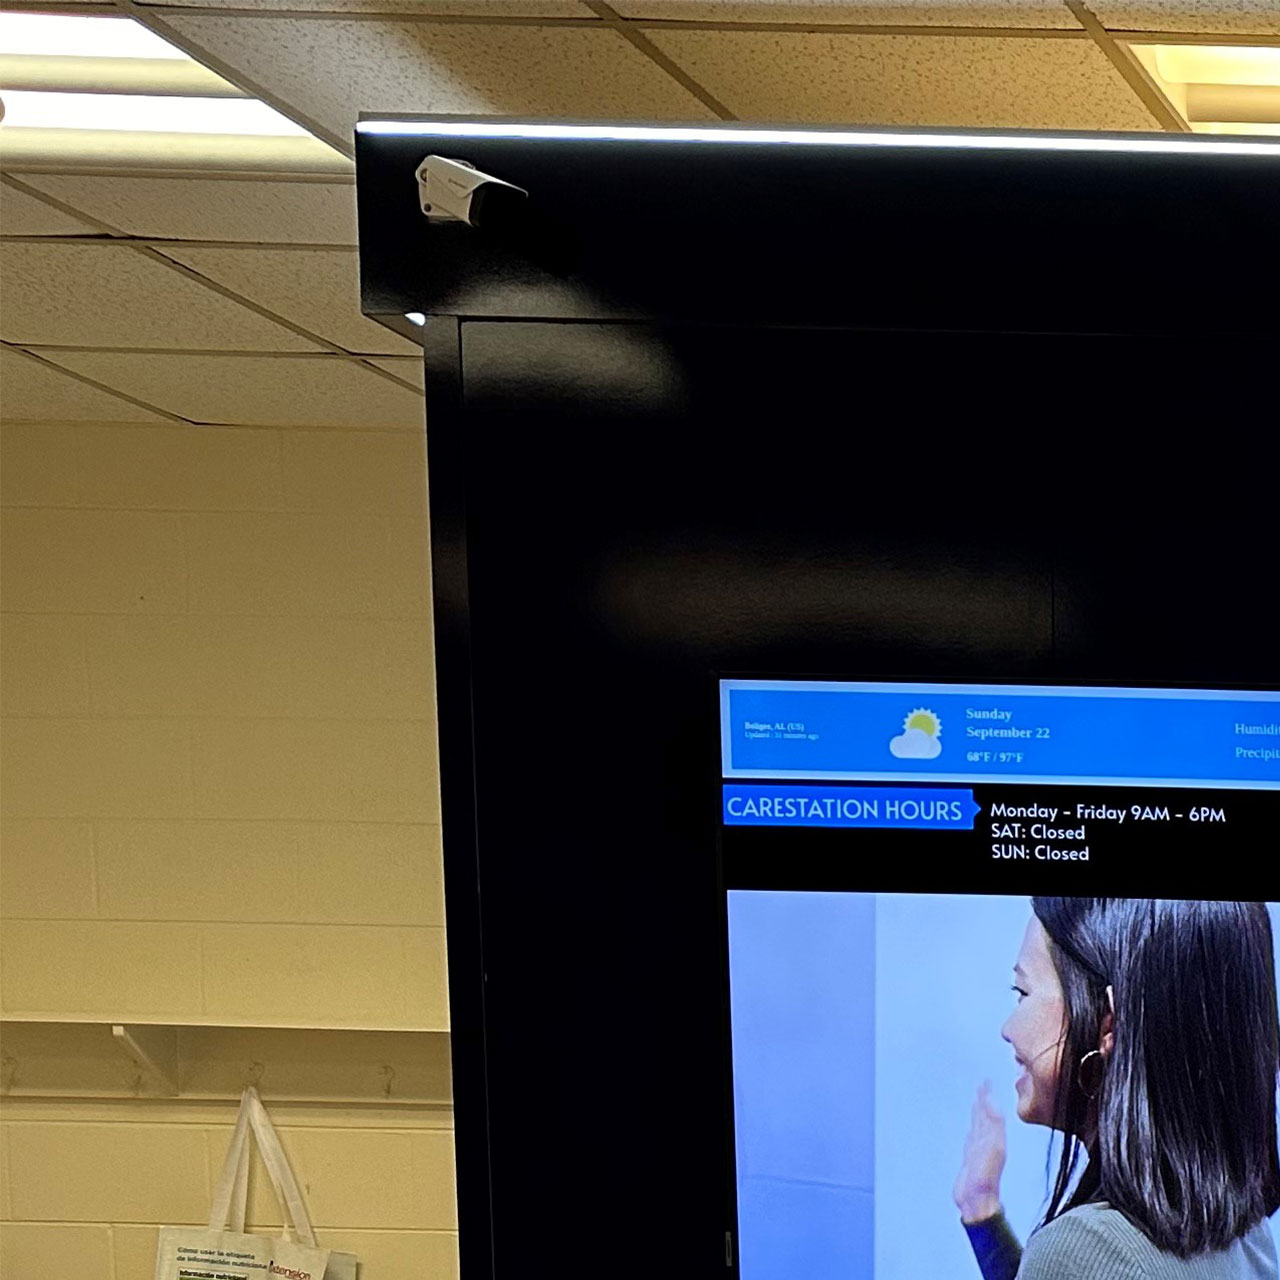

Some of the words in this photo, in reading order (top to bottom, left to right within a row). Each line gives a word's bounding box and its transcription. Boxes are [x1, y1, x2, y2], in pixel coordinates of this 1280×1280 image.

[965, 707, 1012, 723] Sunday
[966, 726, 1033, 740] September
[1035, 727, 1051, 739] 22
[727, 796, 878, 819] CARESTATION
[886, 799, 963, 821] HOURS
[990, 803, 1058, 822] Monday
[1076, 804, 1126, 823] Friday
[1130, 805, 1170, 821] 9AM
[1188, 806, 1226, 822] 6PM
[991, 823, 1026, 839] SAT:
[1030, 824, 1086, 840] Closed
[991, 844, 1030, 860] SUN:
[1034, 844, 1090, 861] Closed
